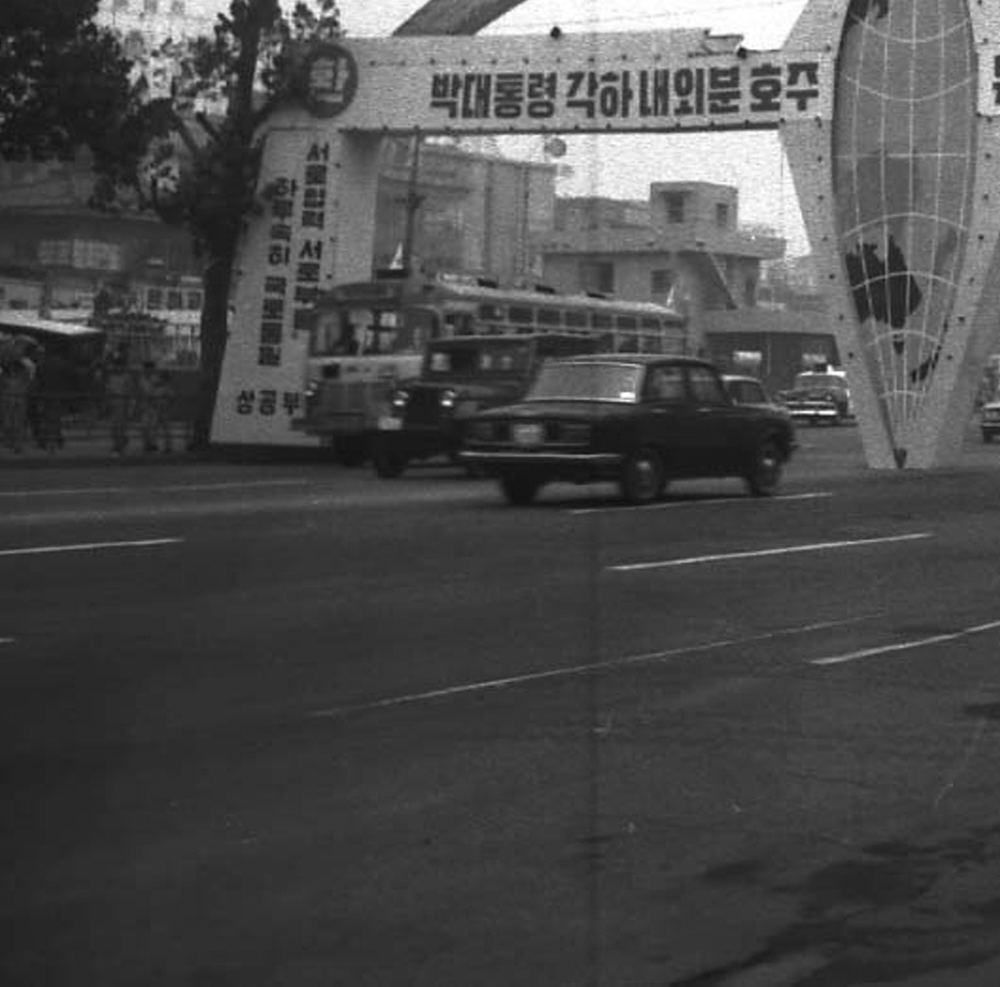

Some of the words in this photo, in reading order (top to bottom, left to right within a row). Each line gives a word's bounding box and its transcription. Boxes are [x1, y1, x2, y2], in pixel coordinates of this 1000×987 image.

[431, 71, 557, 119] 박대통령
[750, 61, 819, 112] 호주
[237, 390, 301, 416] 상공부
